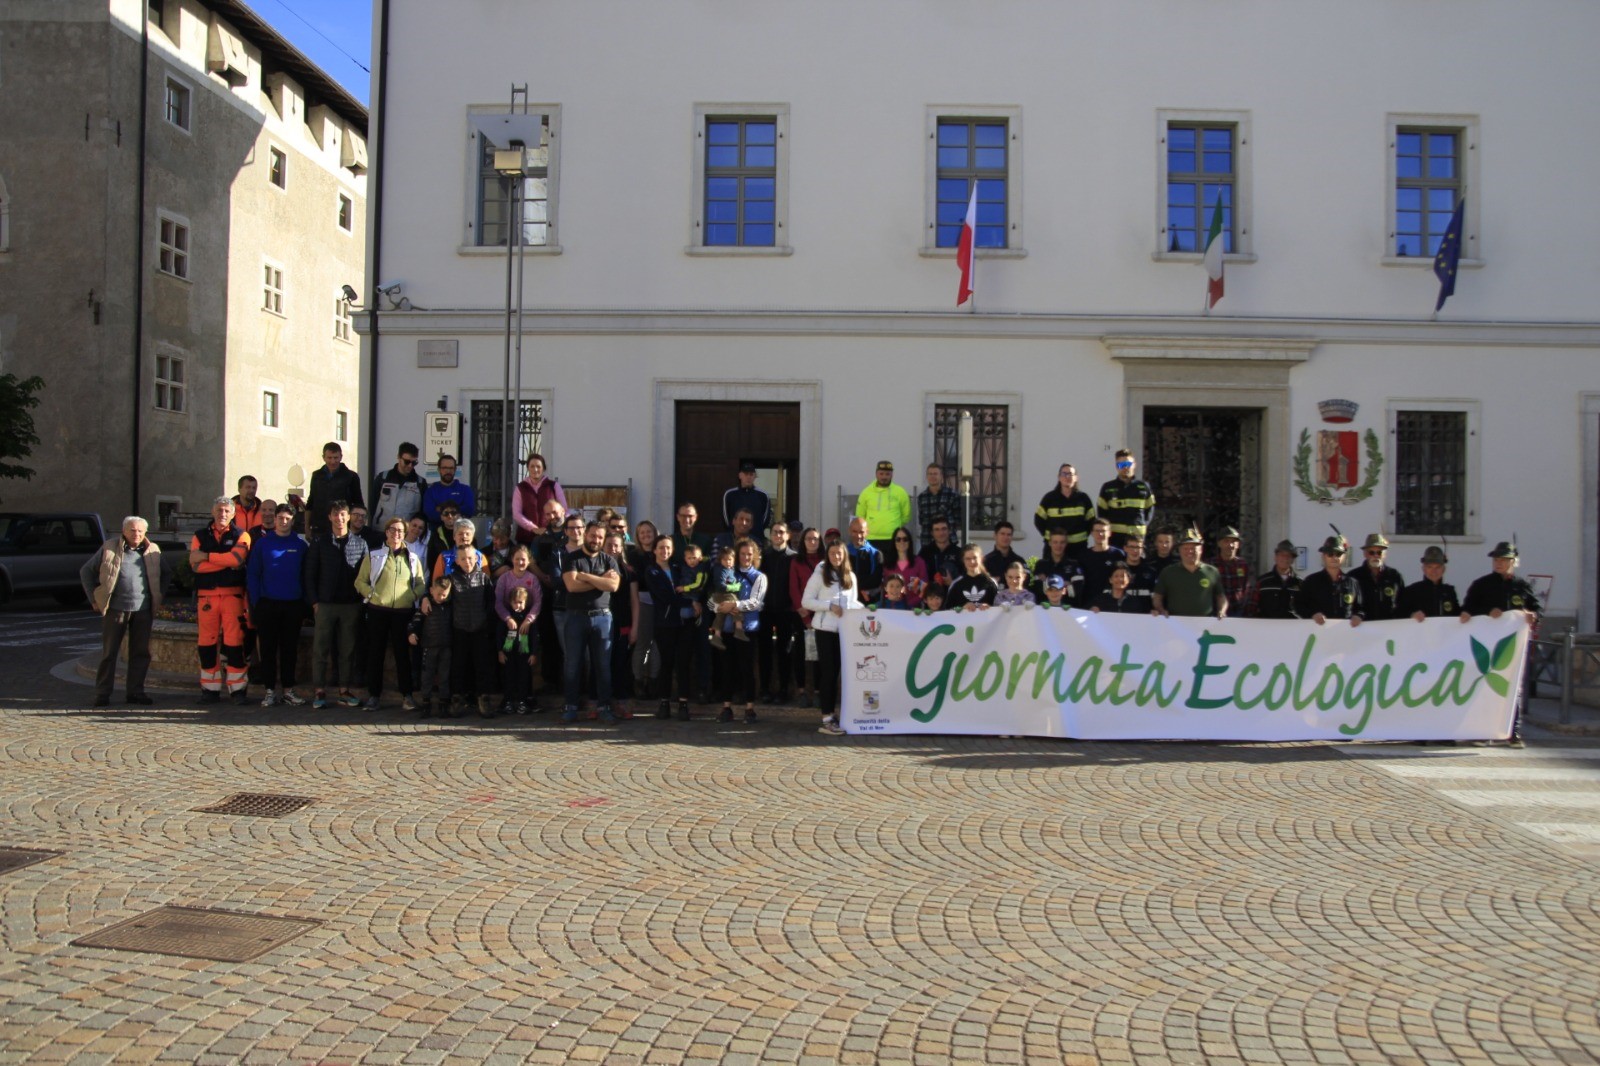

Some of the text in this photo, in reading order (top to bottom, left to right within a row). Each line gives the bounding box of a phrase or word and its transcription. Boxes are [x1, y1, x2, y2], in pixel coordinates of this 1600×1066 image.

[855, 669, 886, 681] CLES
[904, 623, 1486, 735] Giornata Ecologica
